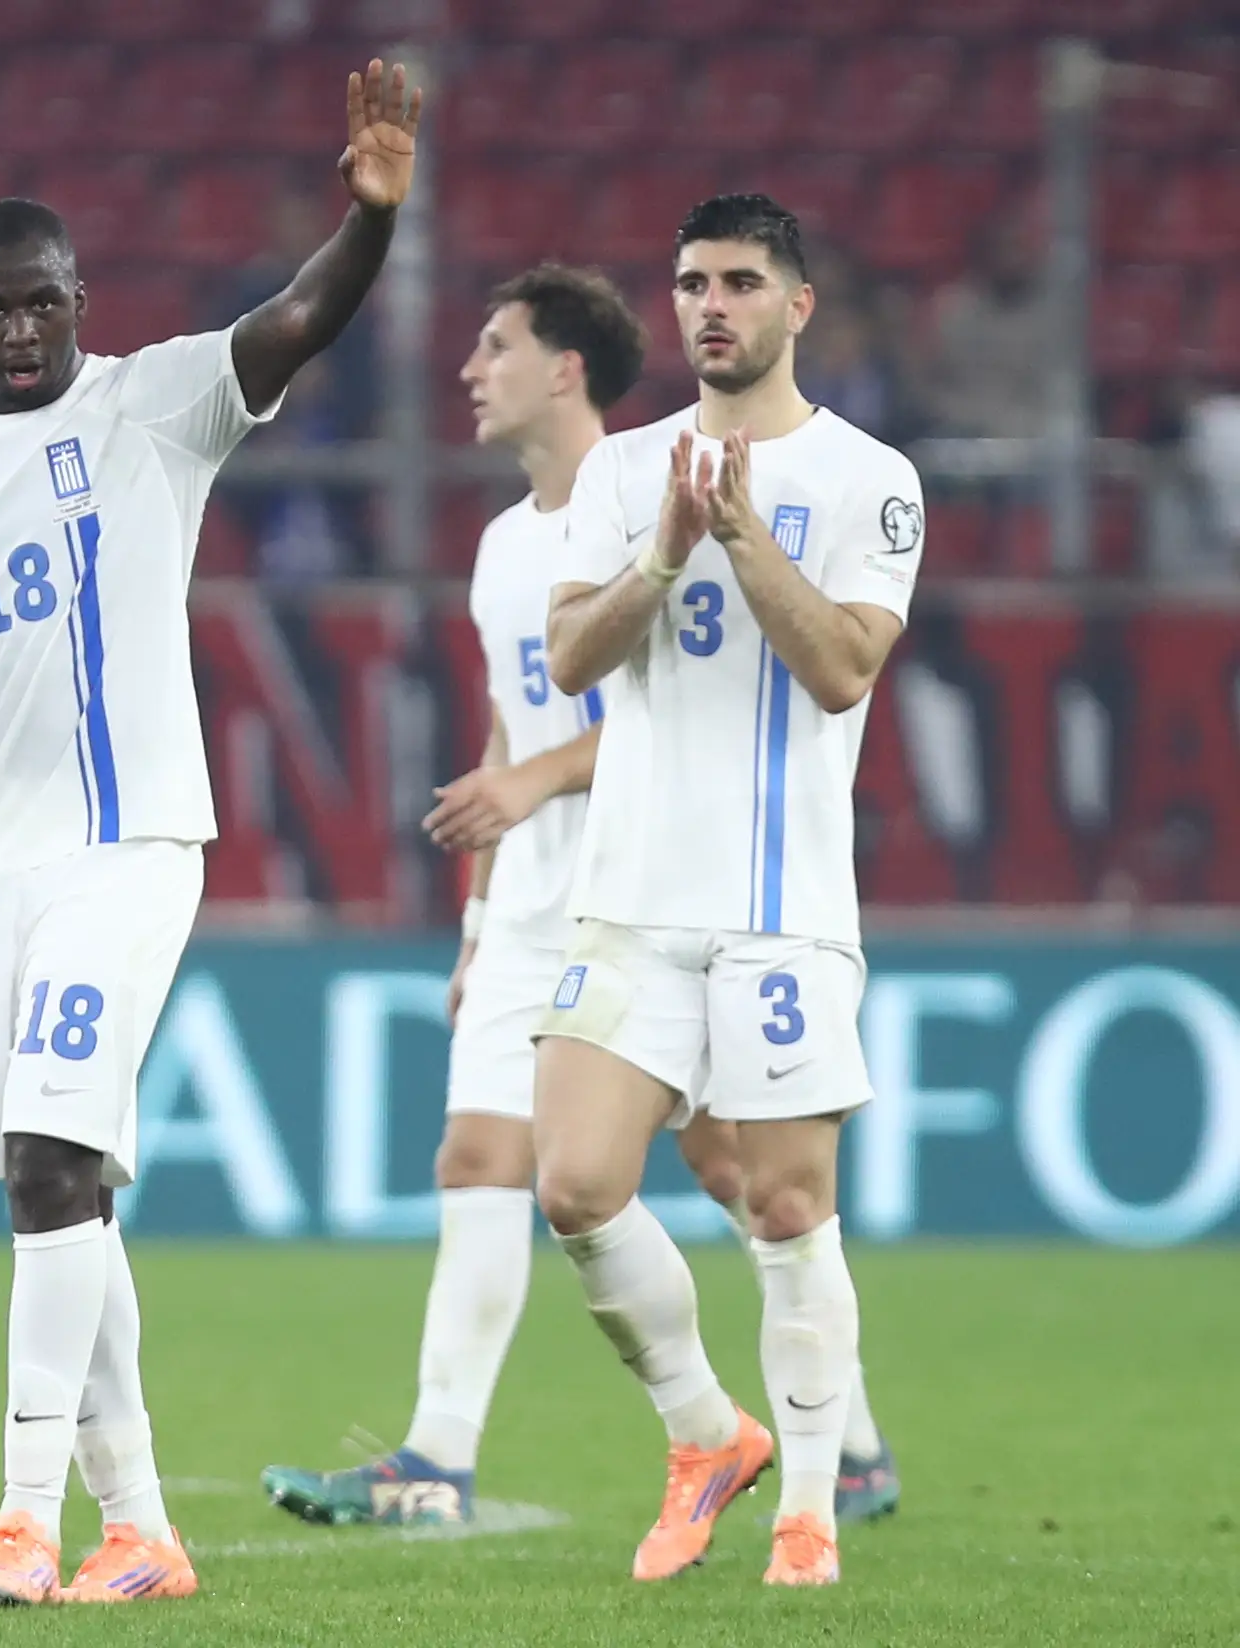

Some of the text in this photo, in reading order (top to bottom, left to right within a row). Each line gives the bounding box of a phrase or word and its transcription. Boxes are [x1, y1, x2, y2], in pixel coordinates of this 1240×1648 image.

[678, 580, 725, 658] 3
[518, 635, 550, 706] 5
[16, 979, 105, 1062] 18
[758, 971, 806, 1046] 3
